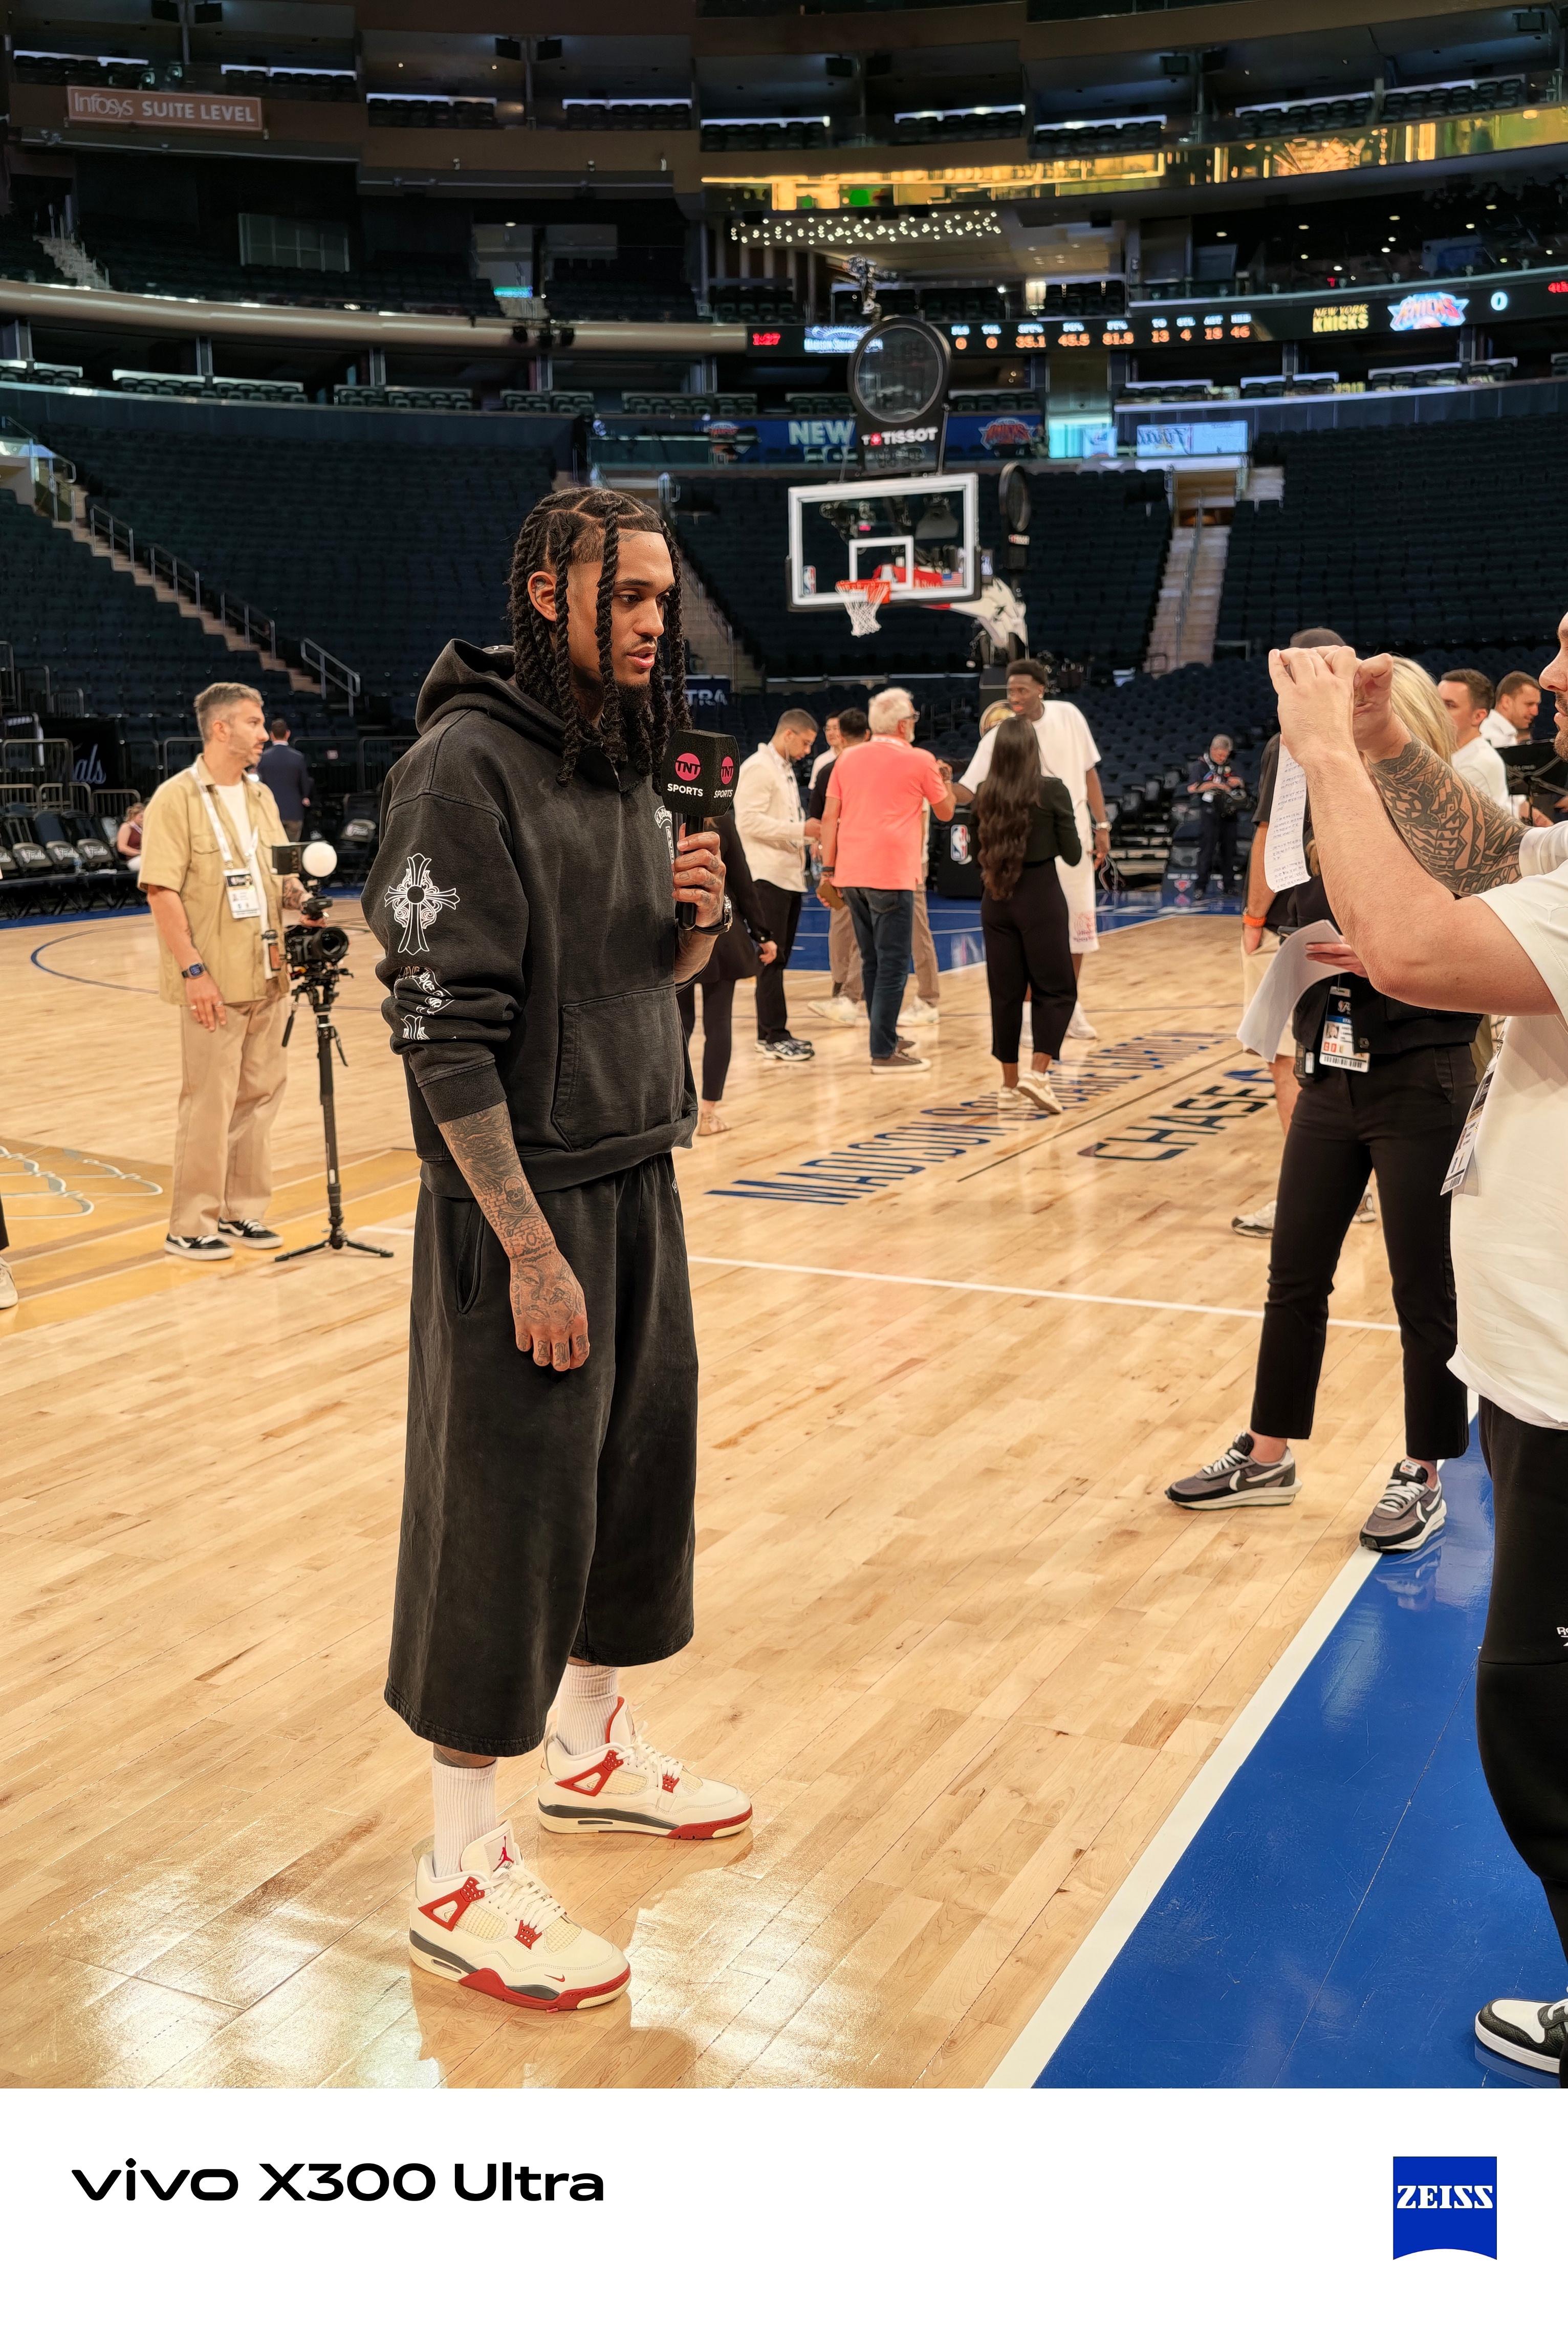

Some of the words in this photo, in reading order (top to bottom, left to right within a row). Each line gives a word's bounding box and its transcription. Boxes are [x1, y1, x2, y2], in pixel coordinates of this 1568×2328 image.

[74, 92, 134, 119] Infosys
[142, 101, 195, 119] SUITE
[200, 104, 256, 122] LEVEL
[1314, 307, 1338, 317] NEW
[1339, 304, 1368, 315] YORK
[1490, 291, 1508, 311] 0
[1180, 329, 1192, 341] 4
[1230, 325, 1251, 338] 46
[1313, 314, 1369, 333] KNICKS
[788, 420, 856, 445] NEW
[881, 426, 939, 446] TISSOT
[676, 760, 701, 775] TNT
[721, 766, 734, 778] TNT
[667, 783, 704, 797] SPORTS
[714, 789, 733, 799] SPORTS
[1077, 1085, 1276, 1162] CHASE
[704, 1122, 1019, 1204] MADISON
